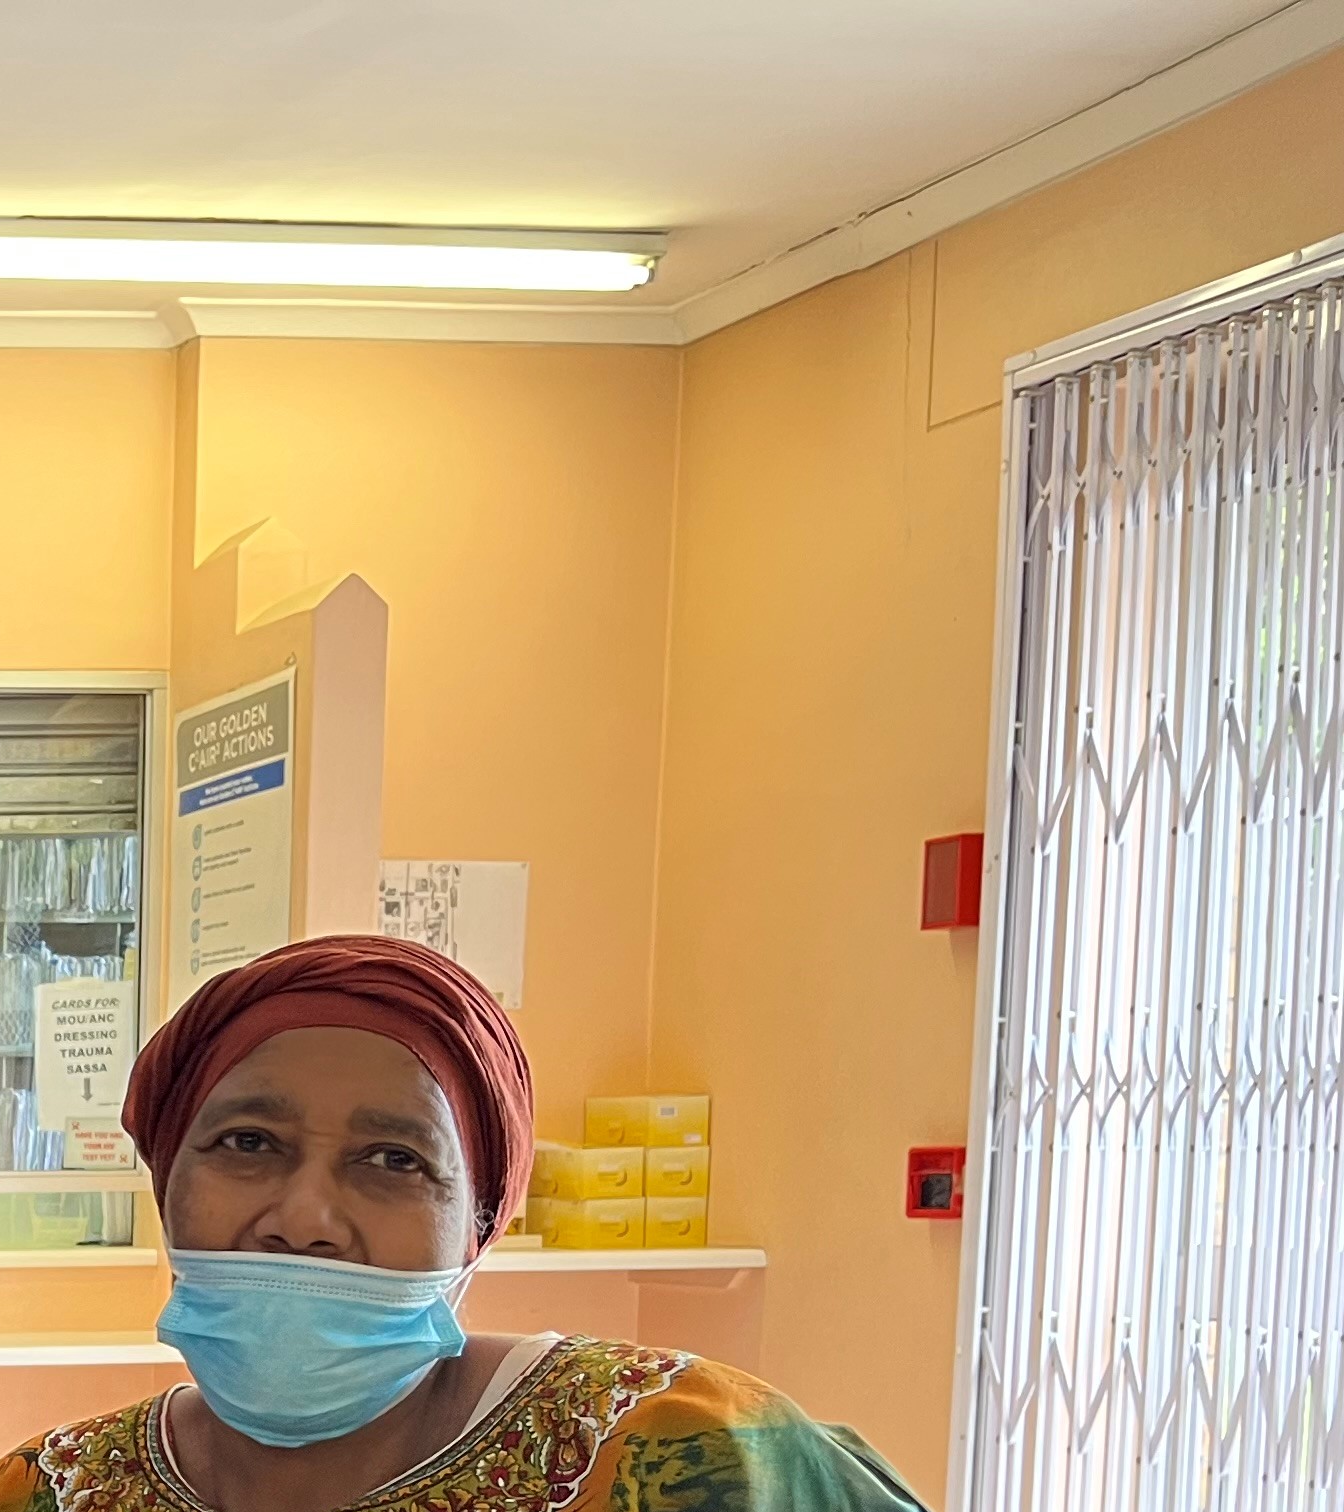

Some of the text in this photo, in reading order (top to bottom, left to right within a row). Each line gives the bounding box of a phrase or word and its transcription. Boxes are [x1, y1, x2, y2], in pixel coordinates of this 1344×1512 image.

[193, 702, 268, 747] OUR GOLDEN
[222, 725, 274, 762] ACTIONS
[52, 999, 92, 1010] CARDS
[54, 1029, 118, 1042] DRESSING
[60, 1046, 113, 1058] TRAUMA
[67, 1063, 108, 1074] SASSA
